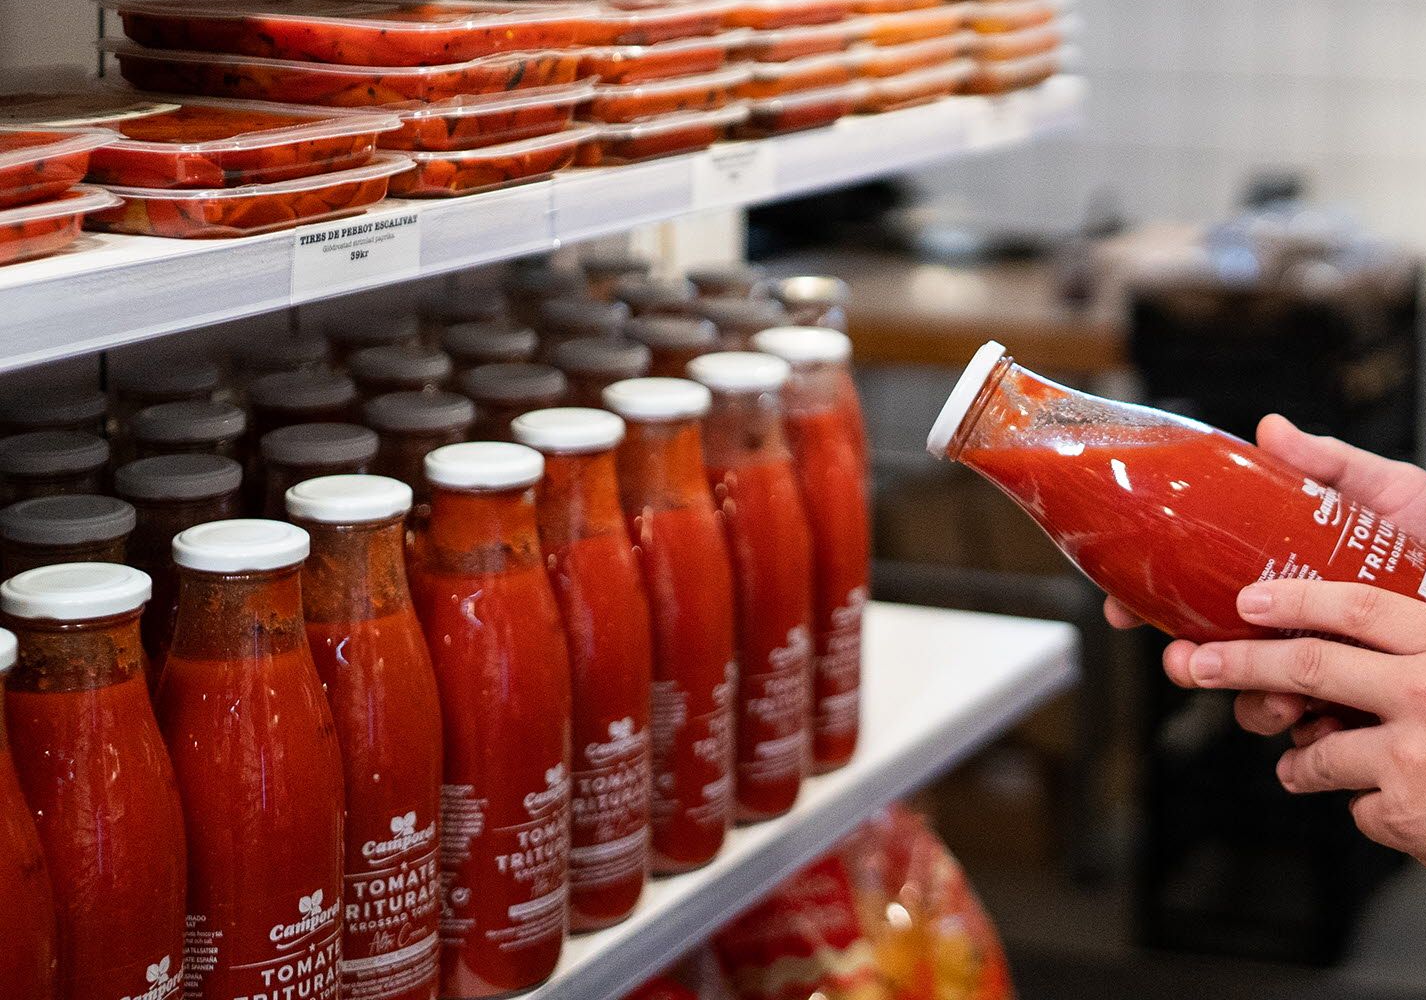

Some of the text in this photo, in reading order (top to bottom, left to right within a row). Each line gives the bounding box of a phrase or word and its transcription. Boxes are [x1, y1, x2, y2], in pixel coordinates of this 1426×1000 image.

[300, 214, 419, 246] TIRES DE PEBROT ESCALIVAT
[350, 250, 369, 261] 39kr
[353, 859, 436, 899] TOMATE
[349, 911, 408, 934] KROSSAD
